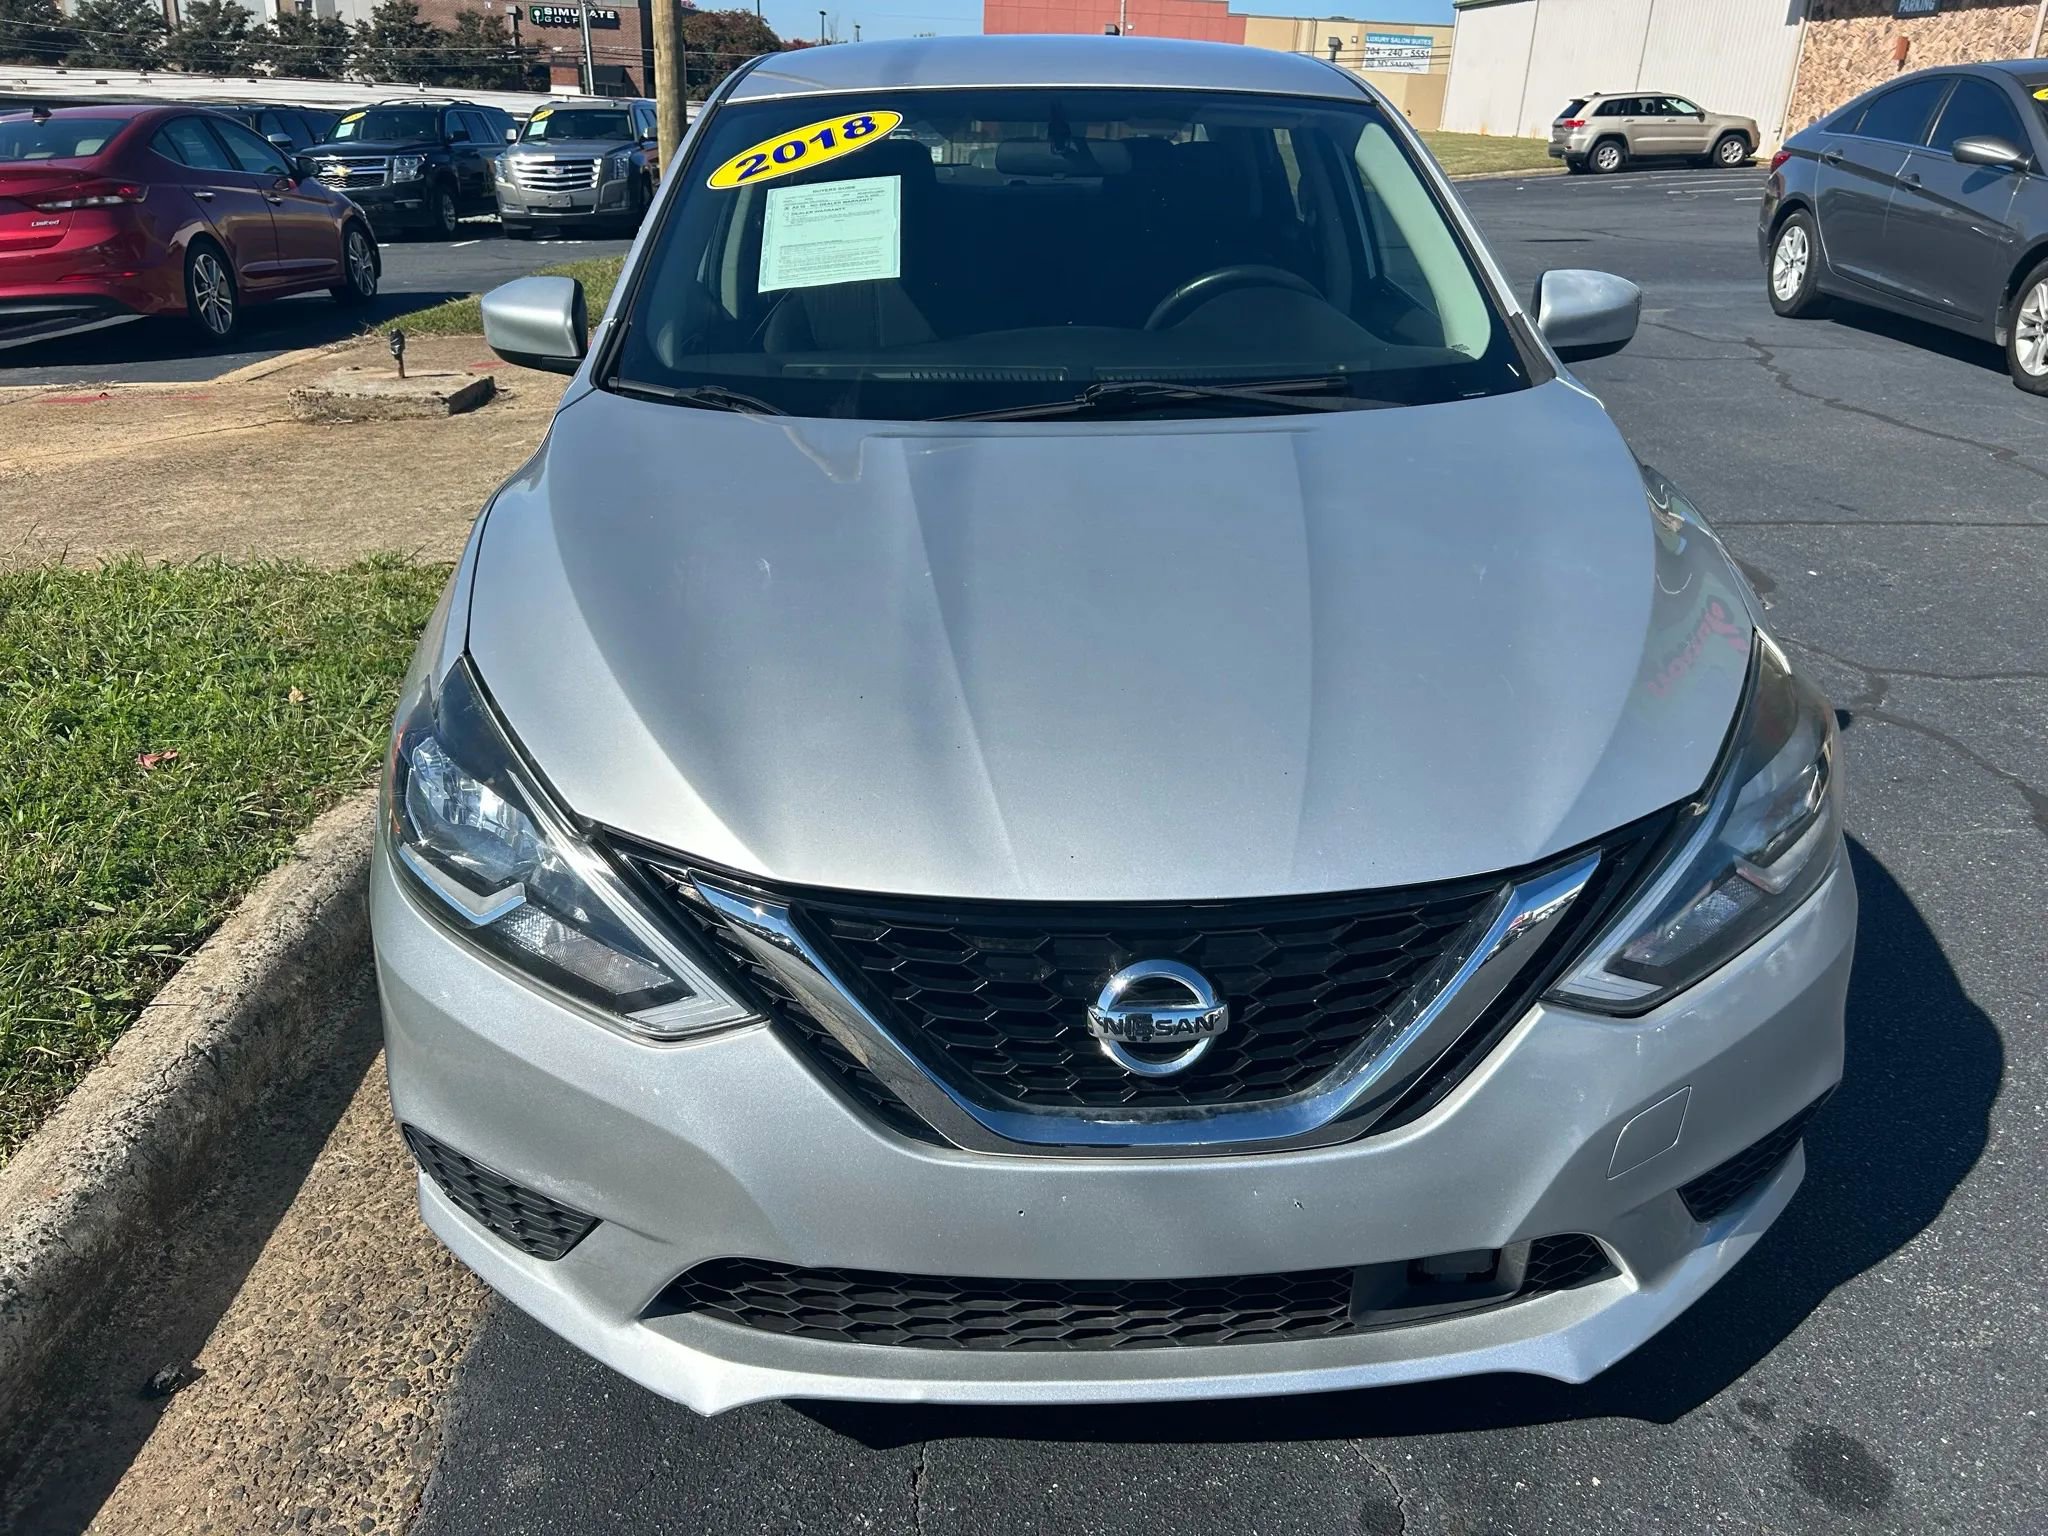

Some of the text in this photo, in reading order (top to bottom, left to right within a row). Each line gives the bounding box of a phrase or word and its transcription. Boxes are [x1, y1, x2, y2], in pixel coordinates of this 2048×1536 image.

[1898, 0, 1936, 12] PARKING
[544, 7, 615, 19] SIMUATE
[544, 16, 579, 24] GOLF
[735, 116, 878, 182] 2018
[31, 219, 60, 227] Limited
[1101, 1012, 1216, 1037] NISSAN
